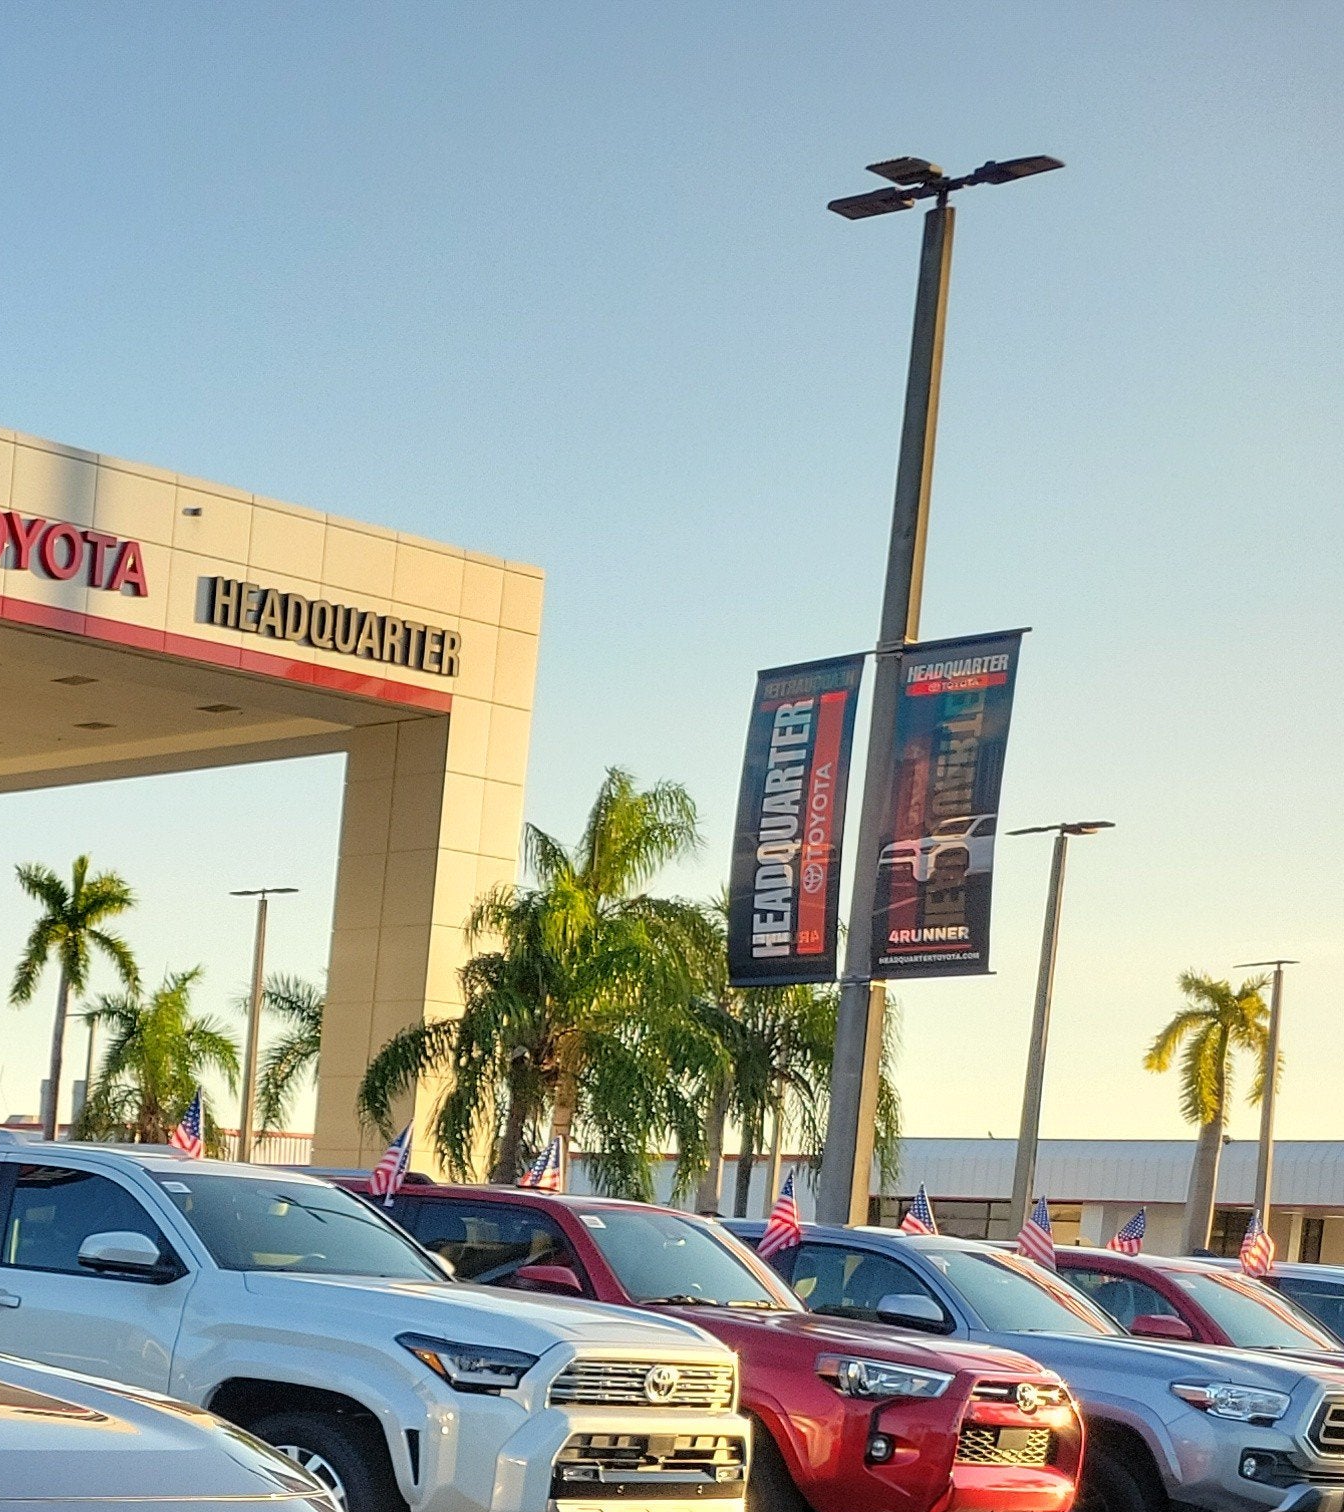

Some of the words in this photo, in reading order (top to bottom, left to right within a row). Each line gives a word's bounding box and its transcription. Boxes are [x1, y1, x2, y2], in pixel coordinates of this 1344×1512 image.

[212, 575, 461, 677] HEADQUARTER
[907, 654, 1009, 682] HEADQUARTER
[942, 677, 980, 691] TOYOTA
[807, 762, 832, 858] TOYOTA
[752, 698, 814, 958] HEADQUARTER
[889, 926, 970, 943] 4RUNNER
[878, 953, 980, 965] HEADQUARTERTOYOTA.COM
